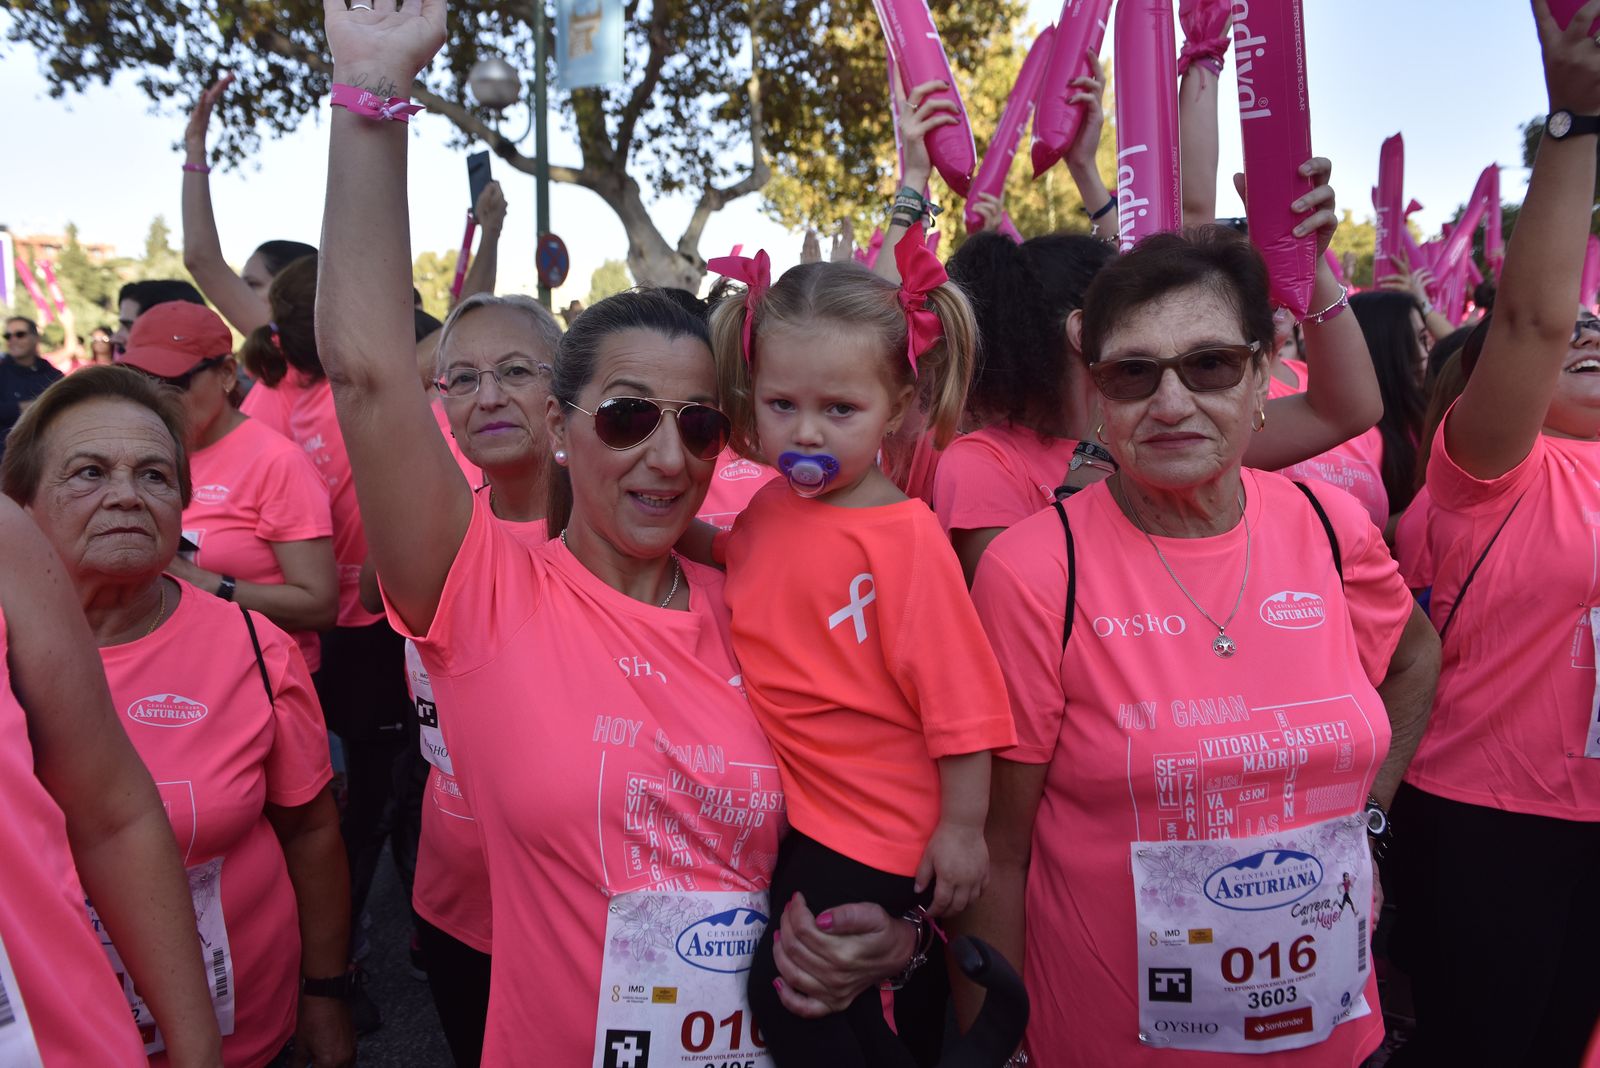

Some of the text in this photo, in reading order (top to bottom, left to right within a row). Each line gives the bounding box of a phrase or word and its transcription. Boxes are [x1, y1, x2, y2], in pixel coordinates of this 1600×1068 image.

[1231, 0, 1272, 120] adival
[1297, 75, 1305, 112] SOLAR
[1267, 606, 1324, 622] ASTURIAN
[1093, 613, 1186, 638] OYSHO
[134, 704, 202, 720] ASTURIANA
[1117, 700, 1157, 730] HOY
[1171, 695, 1250, 728] GANAN
[592, 714, 644, 748] HOY
[1203, 733, 1270, 759] VITORIA
[1283, 721, 1349, 747] GASTEIZ
[424, 738, 449, 759] SHO
[1156, 758, 1177, 776] SE
[1243, 748, 1309, 772] MADRID
[628, 778, 648, 797] SE
[671, 771, 733, 807] VITORIA
[750, 791, 786, 811] GAST
[1157, 776, 1173, 793] VI
[627, 795, 641, 813] VI
[1160, 792, 1179, 807] LL
[1207, 793, 1224, 810] VA
[700, 800, 765, 829] MADRID
[1208, 808, 1234, 827] LEN
[664, 817, 679, 834] VA
[666, 832, 689, 853] LEN
[670, 850, 694, 868] CIA
[1214, 870, 1318, 900] ASTURIANA
[1234, 871, 1274, 881] CENTRAL
[1291, 898, 1332, 918] Carrera
[1164, 929, 1181, 937] IMD
[1221, 934, 1318, 984] 016
[628, 985, 645, 994] IMD
[1247, 985, 1298, 1010] 3603
[1154, 1019, 1219, 1035] OYSHO
[1265, 1017, 1305, 1032] Santander
[714, 1053, 745, 1061] VIOLENCIA
